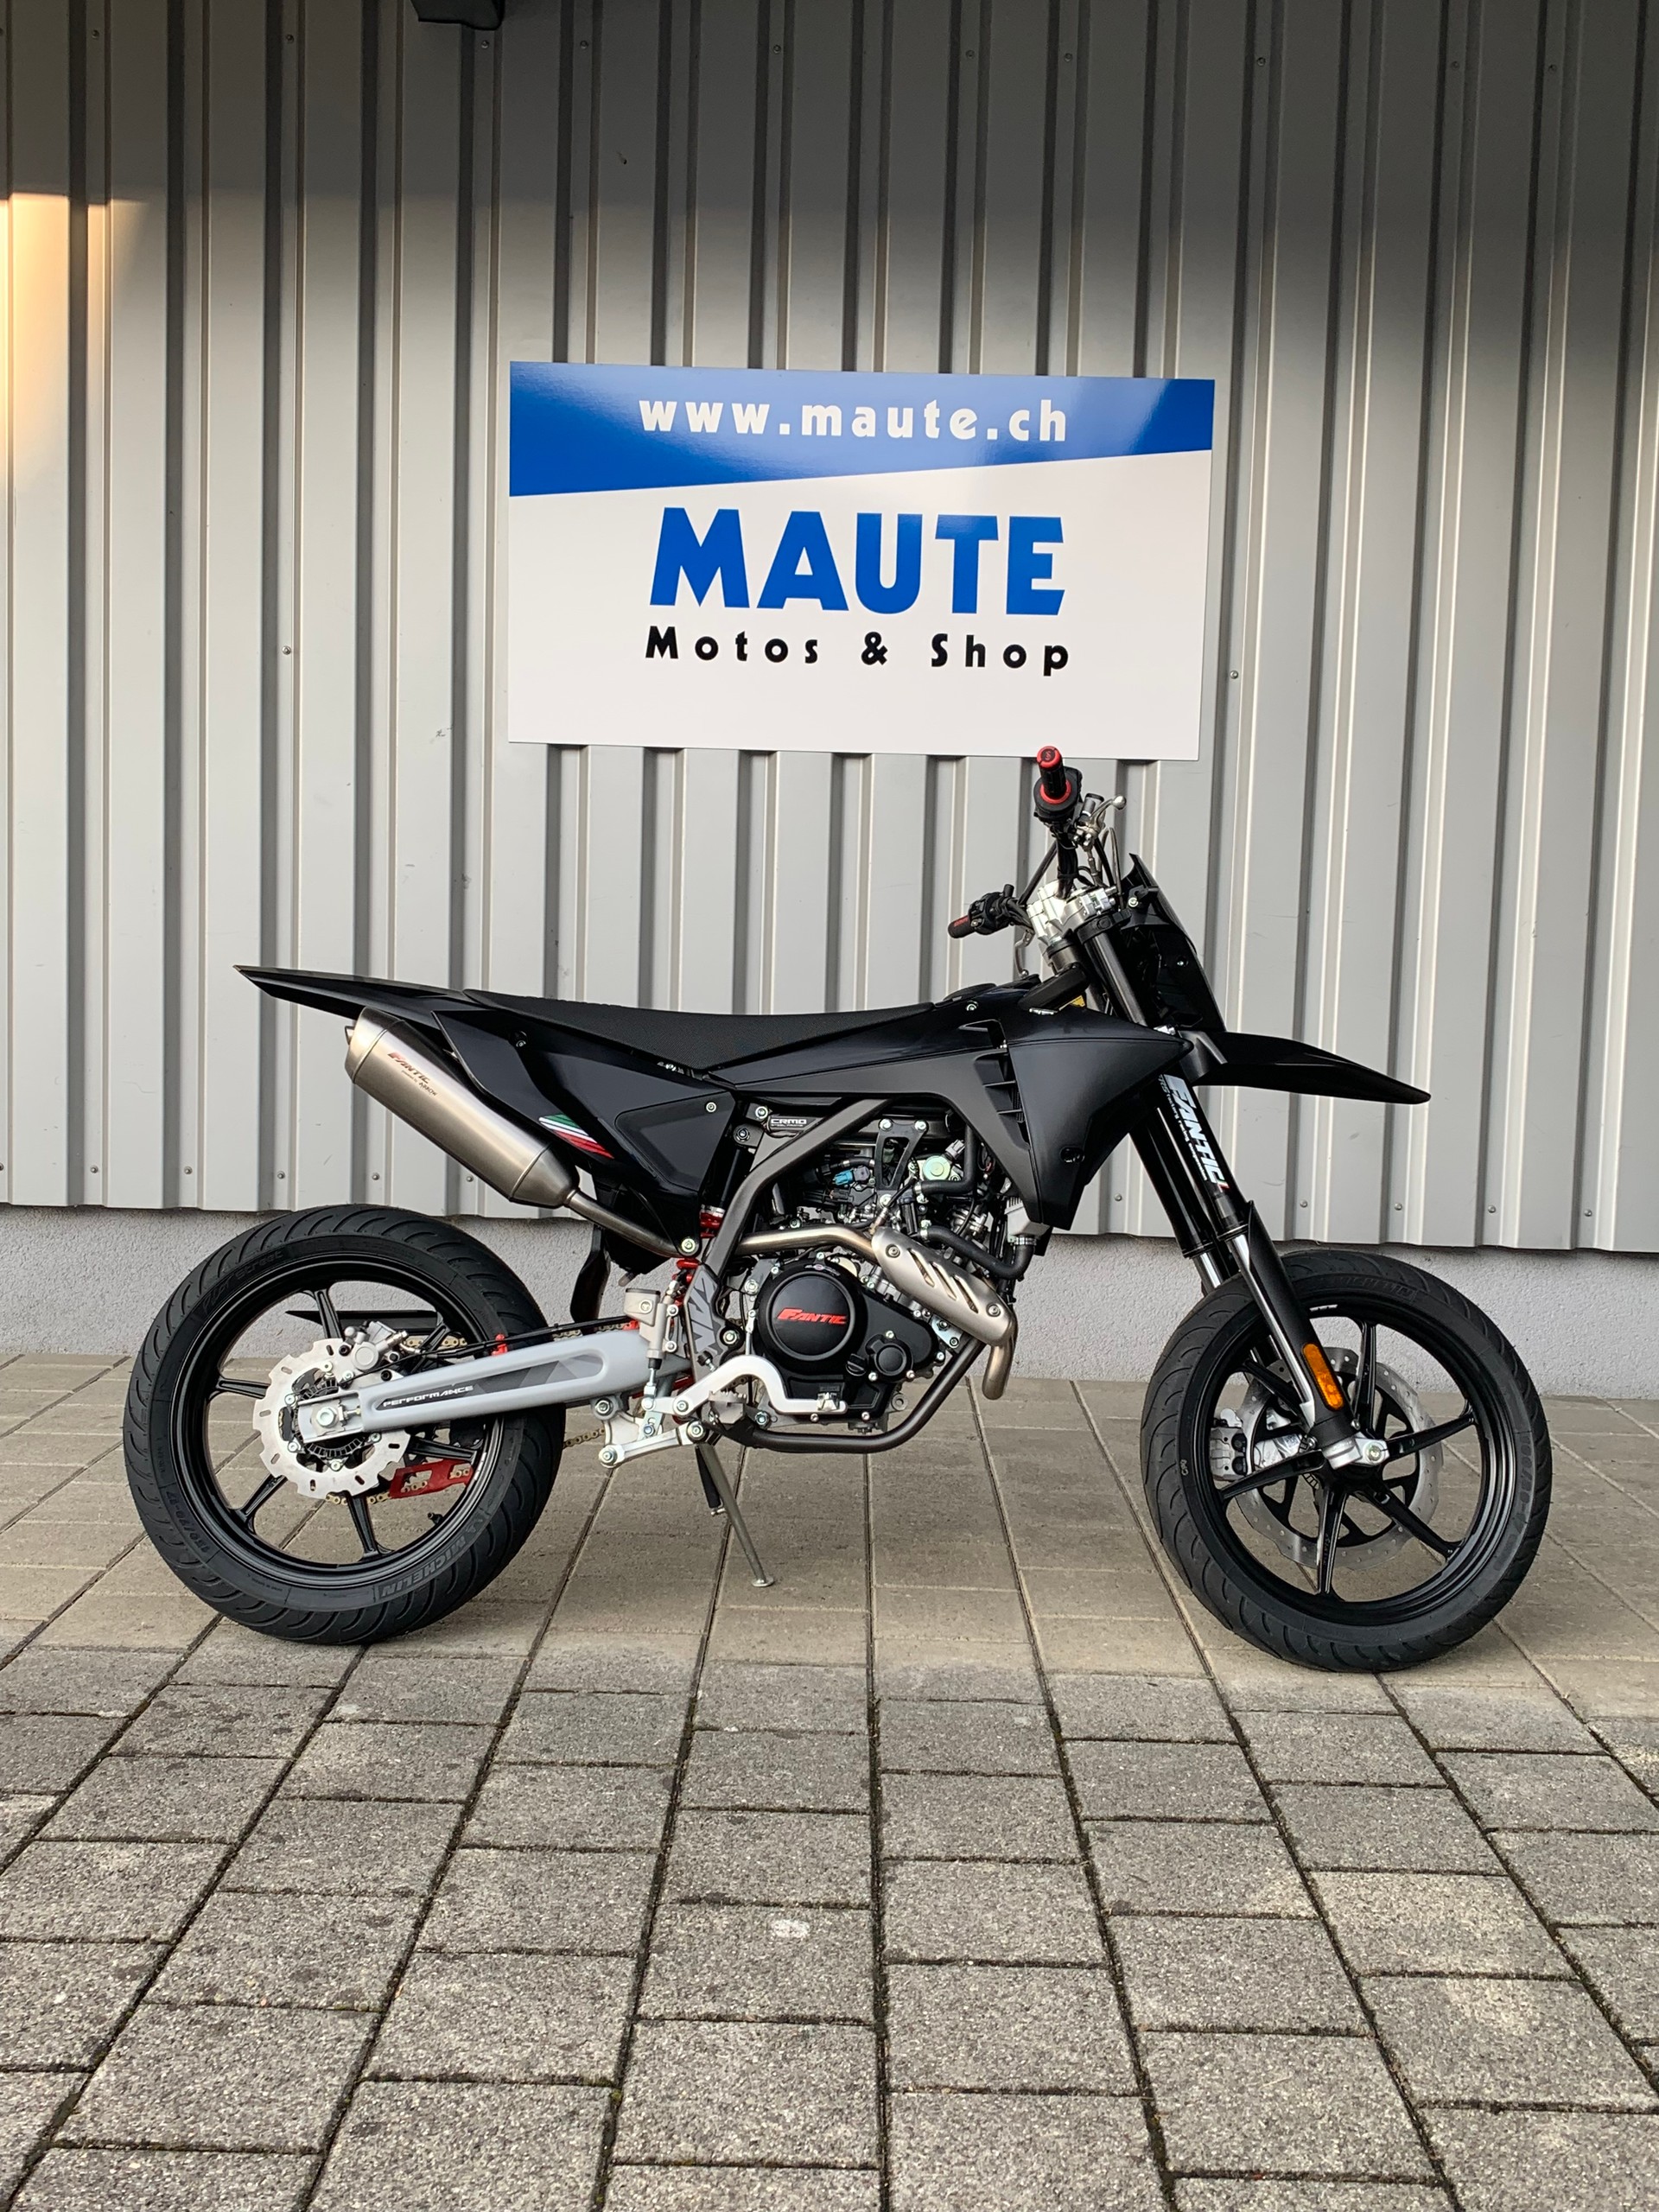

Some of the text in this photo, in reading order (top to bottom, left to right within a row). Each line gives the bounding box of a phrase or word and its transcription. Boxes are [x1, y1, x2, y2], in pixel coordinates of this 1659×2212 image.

[639, 399, 1066, 442] www.maute.ch
[650, 506, 1065, 615] MAUTE
[645, 626, 1069, 677] Motos & Shop
[387, 1052, 431, 1084] FANTIC
[1163, 1074, 1226, 1185] FANTIC
[1166, 1094, 1180, 1120] factory
[1179, 1120, 1191, 1142] racing
[1188, 1142, 1208, 1182] suspension
[778, 1307, 847, 1324] FANTIC
[383, 1384, 474, 1408] PERFORMANCE
[380, 1535, 467, 1598] MICHELIN
